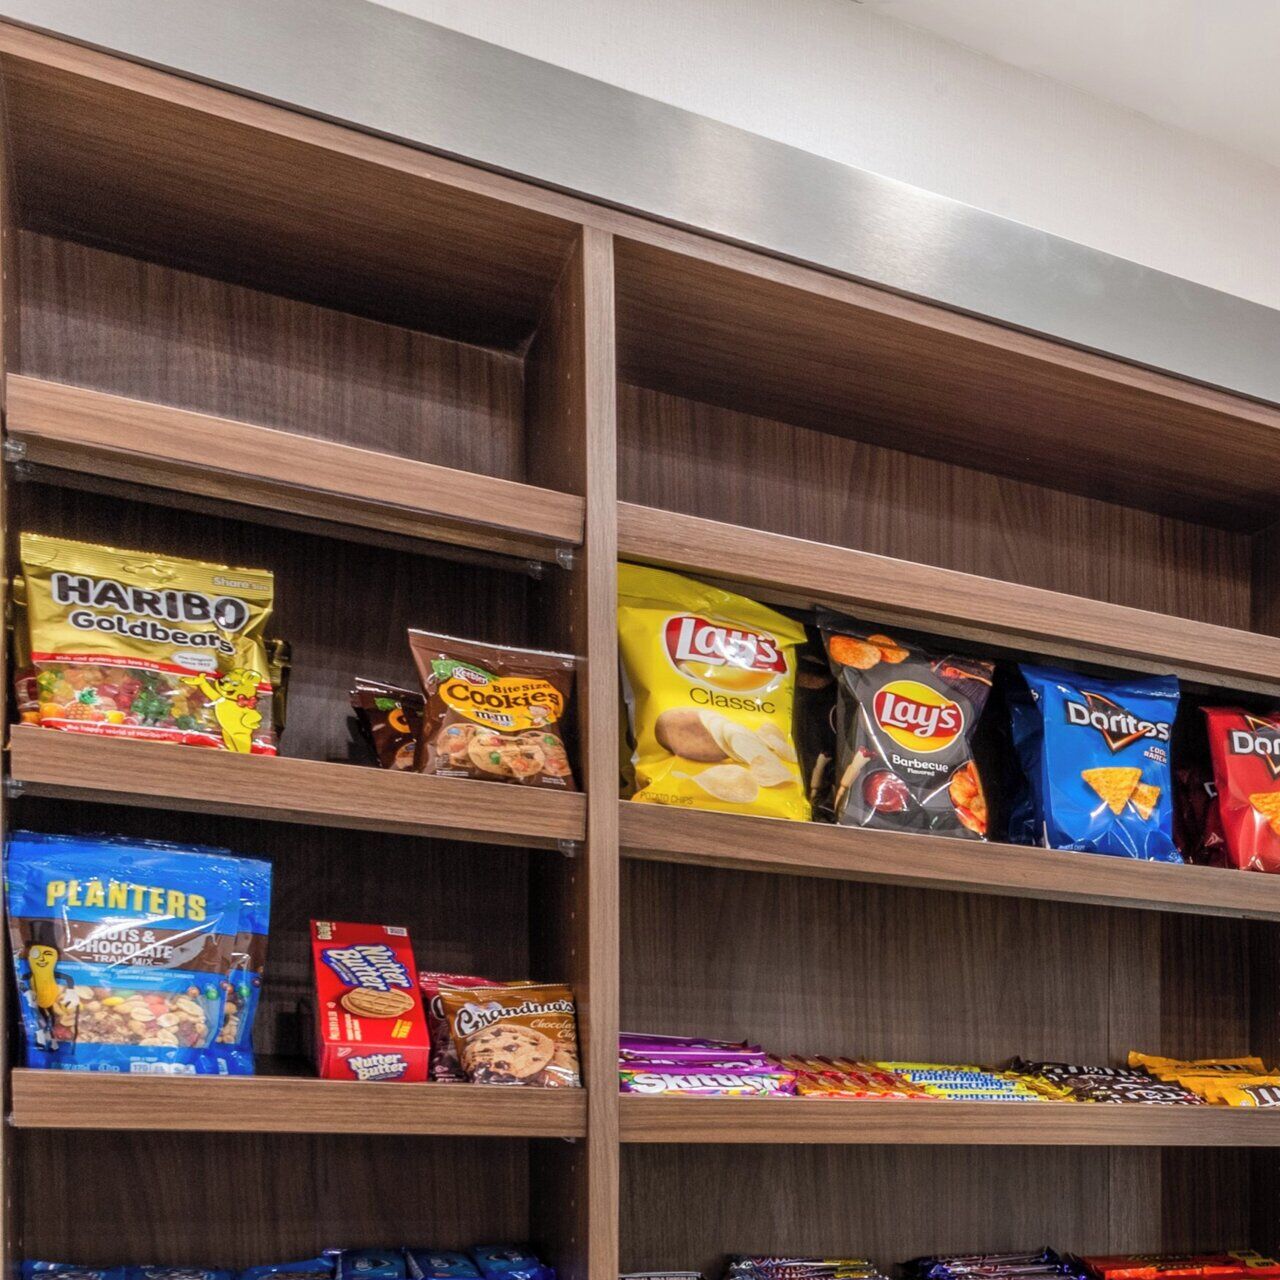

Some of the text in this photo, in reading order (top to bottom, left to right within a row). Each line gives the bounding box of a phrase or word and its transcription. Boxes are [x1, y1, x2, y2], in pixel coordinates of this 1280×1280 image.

[213, 576, 250, 589] Share
[52, 573, 249, 633] HARIBO
[71, 610, 235, 655] Goldbears
[675, 618, 780, 667] Lay's
[447, 684, 559, 709] Cookies
[493, 683, 550, 694] Bite Size
[689, 687, 776, 715] Classic
[881, 693, 957, 737] Lay's
[1067, 701, 1171, 741] Doritos
[892, 754, 949, 773] Barbecue
[46, 880, 207, 922] PLANTERS
[73, 938, 174, 959] CHOCOLATE
[455, 1000, 575, 1038] Grandma's
[350, 1054, 402, 1069] Nutter
